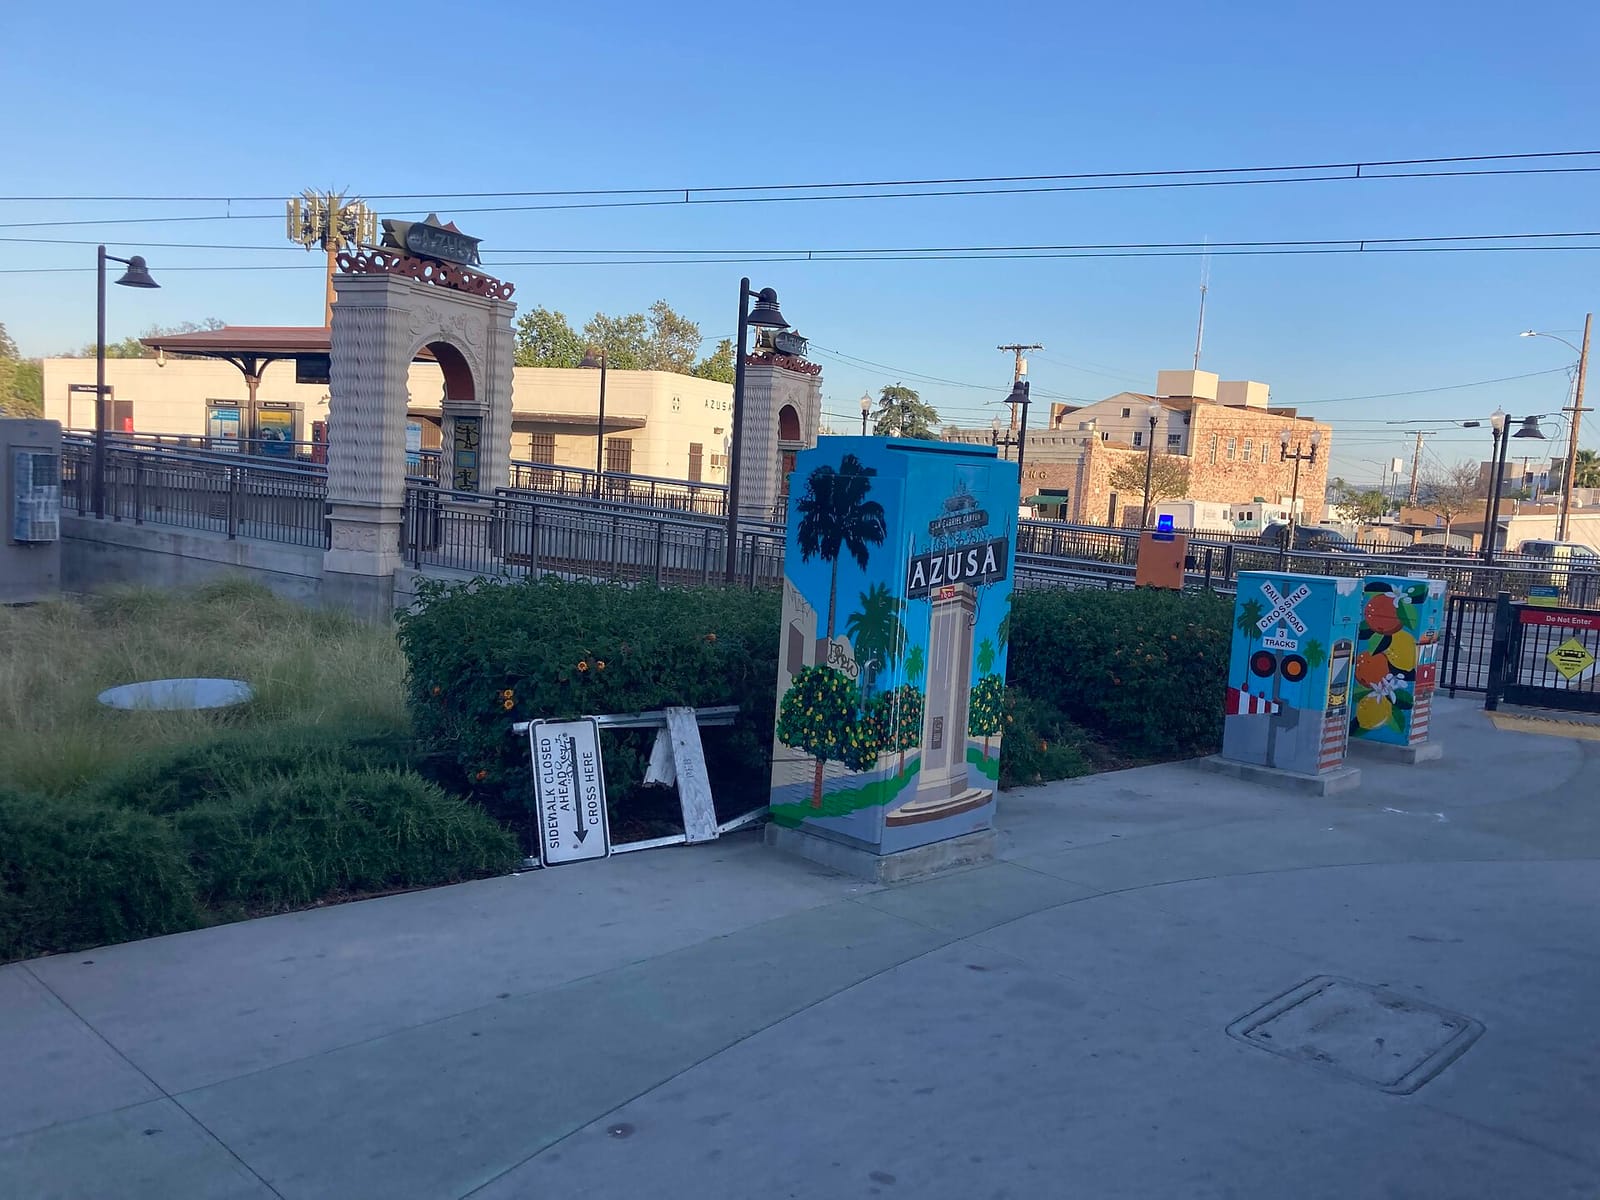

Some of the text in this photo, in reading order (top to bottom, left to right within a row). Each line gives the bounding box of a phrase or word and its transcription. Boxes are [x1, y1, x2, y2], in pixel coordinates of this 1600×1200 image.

[909, 544, 997, 589] AZUSA
[1261, 588, 1307, 628] CROSSING
[1264, 584, 1304, 633] RAIL ROAD
[1572, 617, 1592, 625] Enter
[1265, 638, 1296, 649] TRACKS
[1279, 630, 1285, 638] 3
[541, 738, 560, 849] SIDEWALK CLOSED
[557, 770, 570, 812] AHEAD
[583, 751, 599, 825] CROSS HERE
